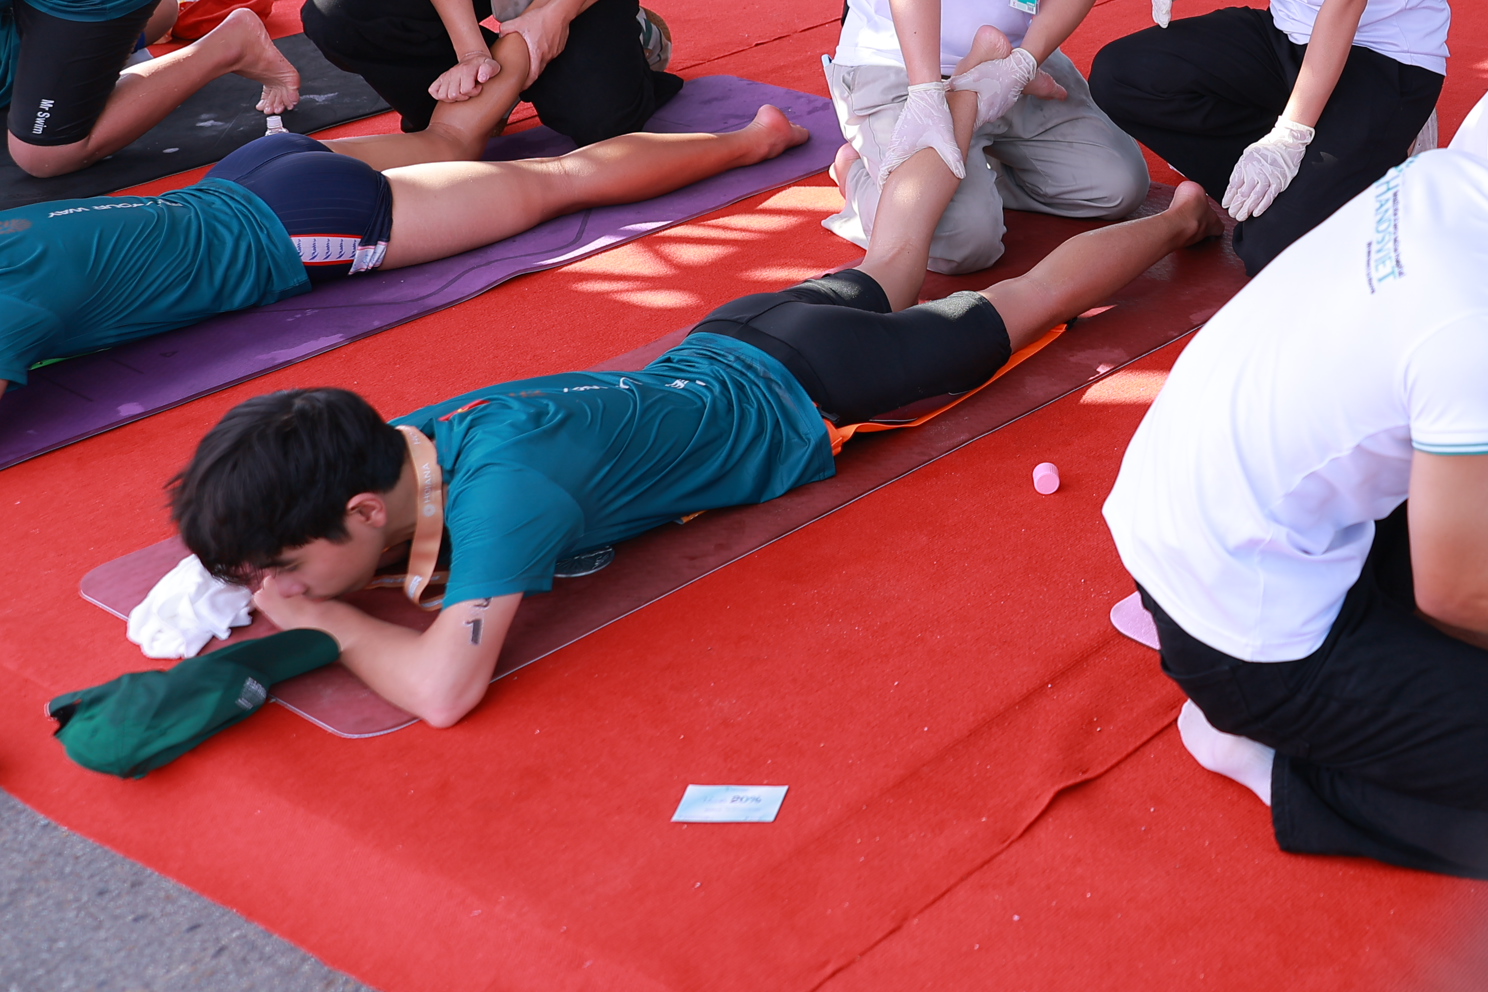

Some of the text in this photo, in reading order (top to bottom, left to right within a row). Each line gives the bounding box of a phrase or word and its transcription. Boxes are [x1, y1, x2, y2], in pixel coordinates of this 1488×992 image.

[32, 98, 55, 135] Mr Swim
[1375, 174, 1400, 283] HANDSVIET
